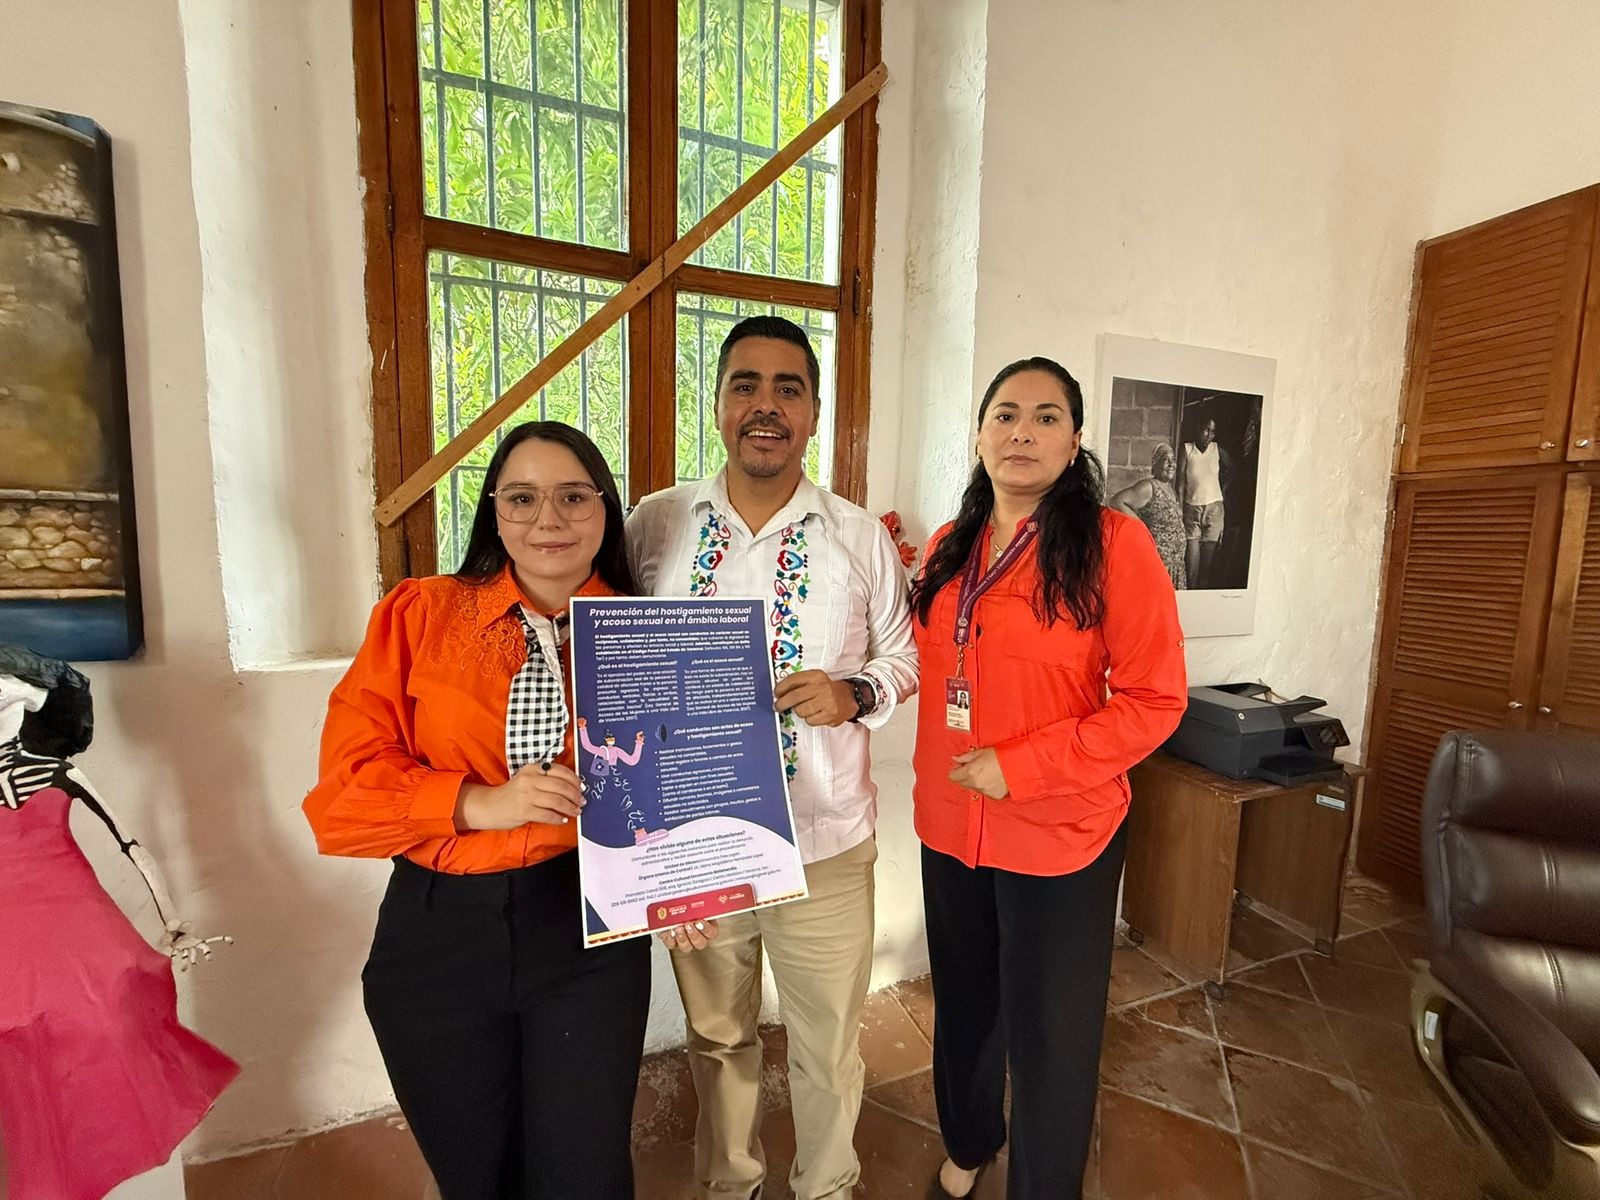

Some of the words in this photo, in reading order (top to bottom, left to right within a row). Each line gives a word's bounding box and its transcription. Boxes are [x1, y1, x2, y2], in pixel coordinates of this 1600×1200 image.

[589, 608, 643, 616] Prevención
[660, 607, 723, 617] hostigamiento
[725, 606, 752, 614] sexual
[594, 619, 601, 628] y
[633, 617, 663, 626] sexual
[678, 615, 686, 624] el
[687, 615, 718, 624] ámbito
